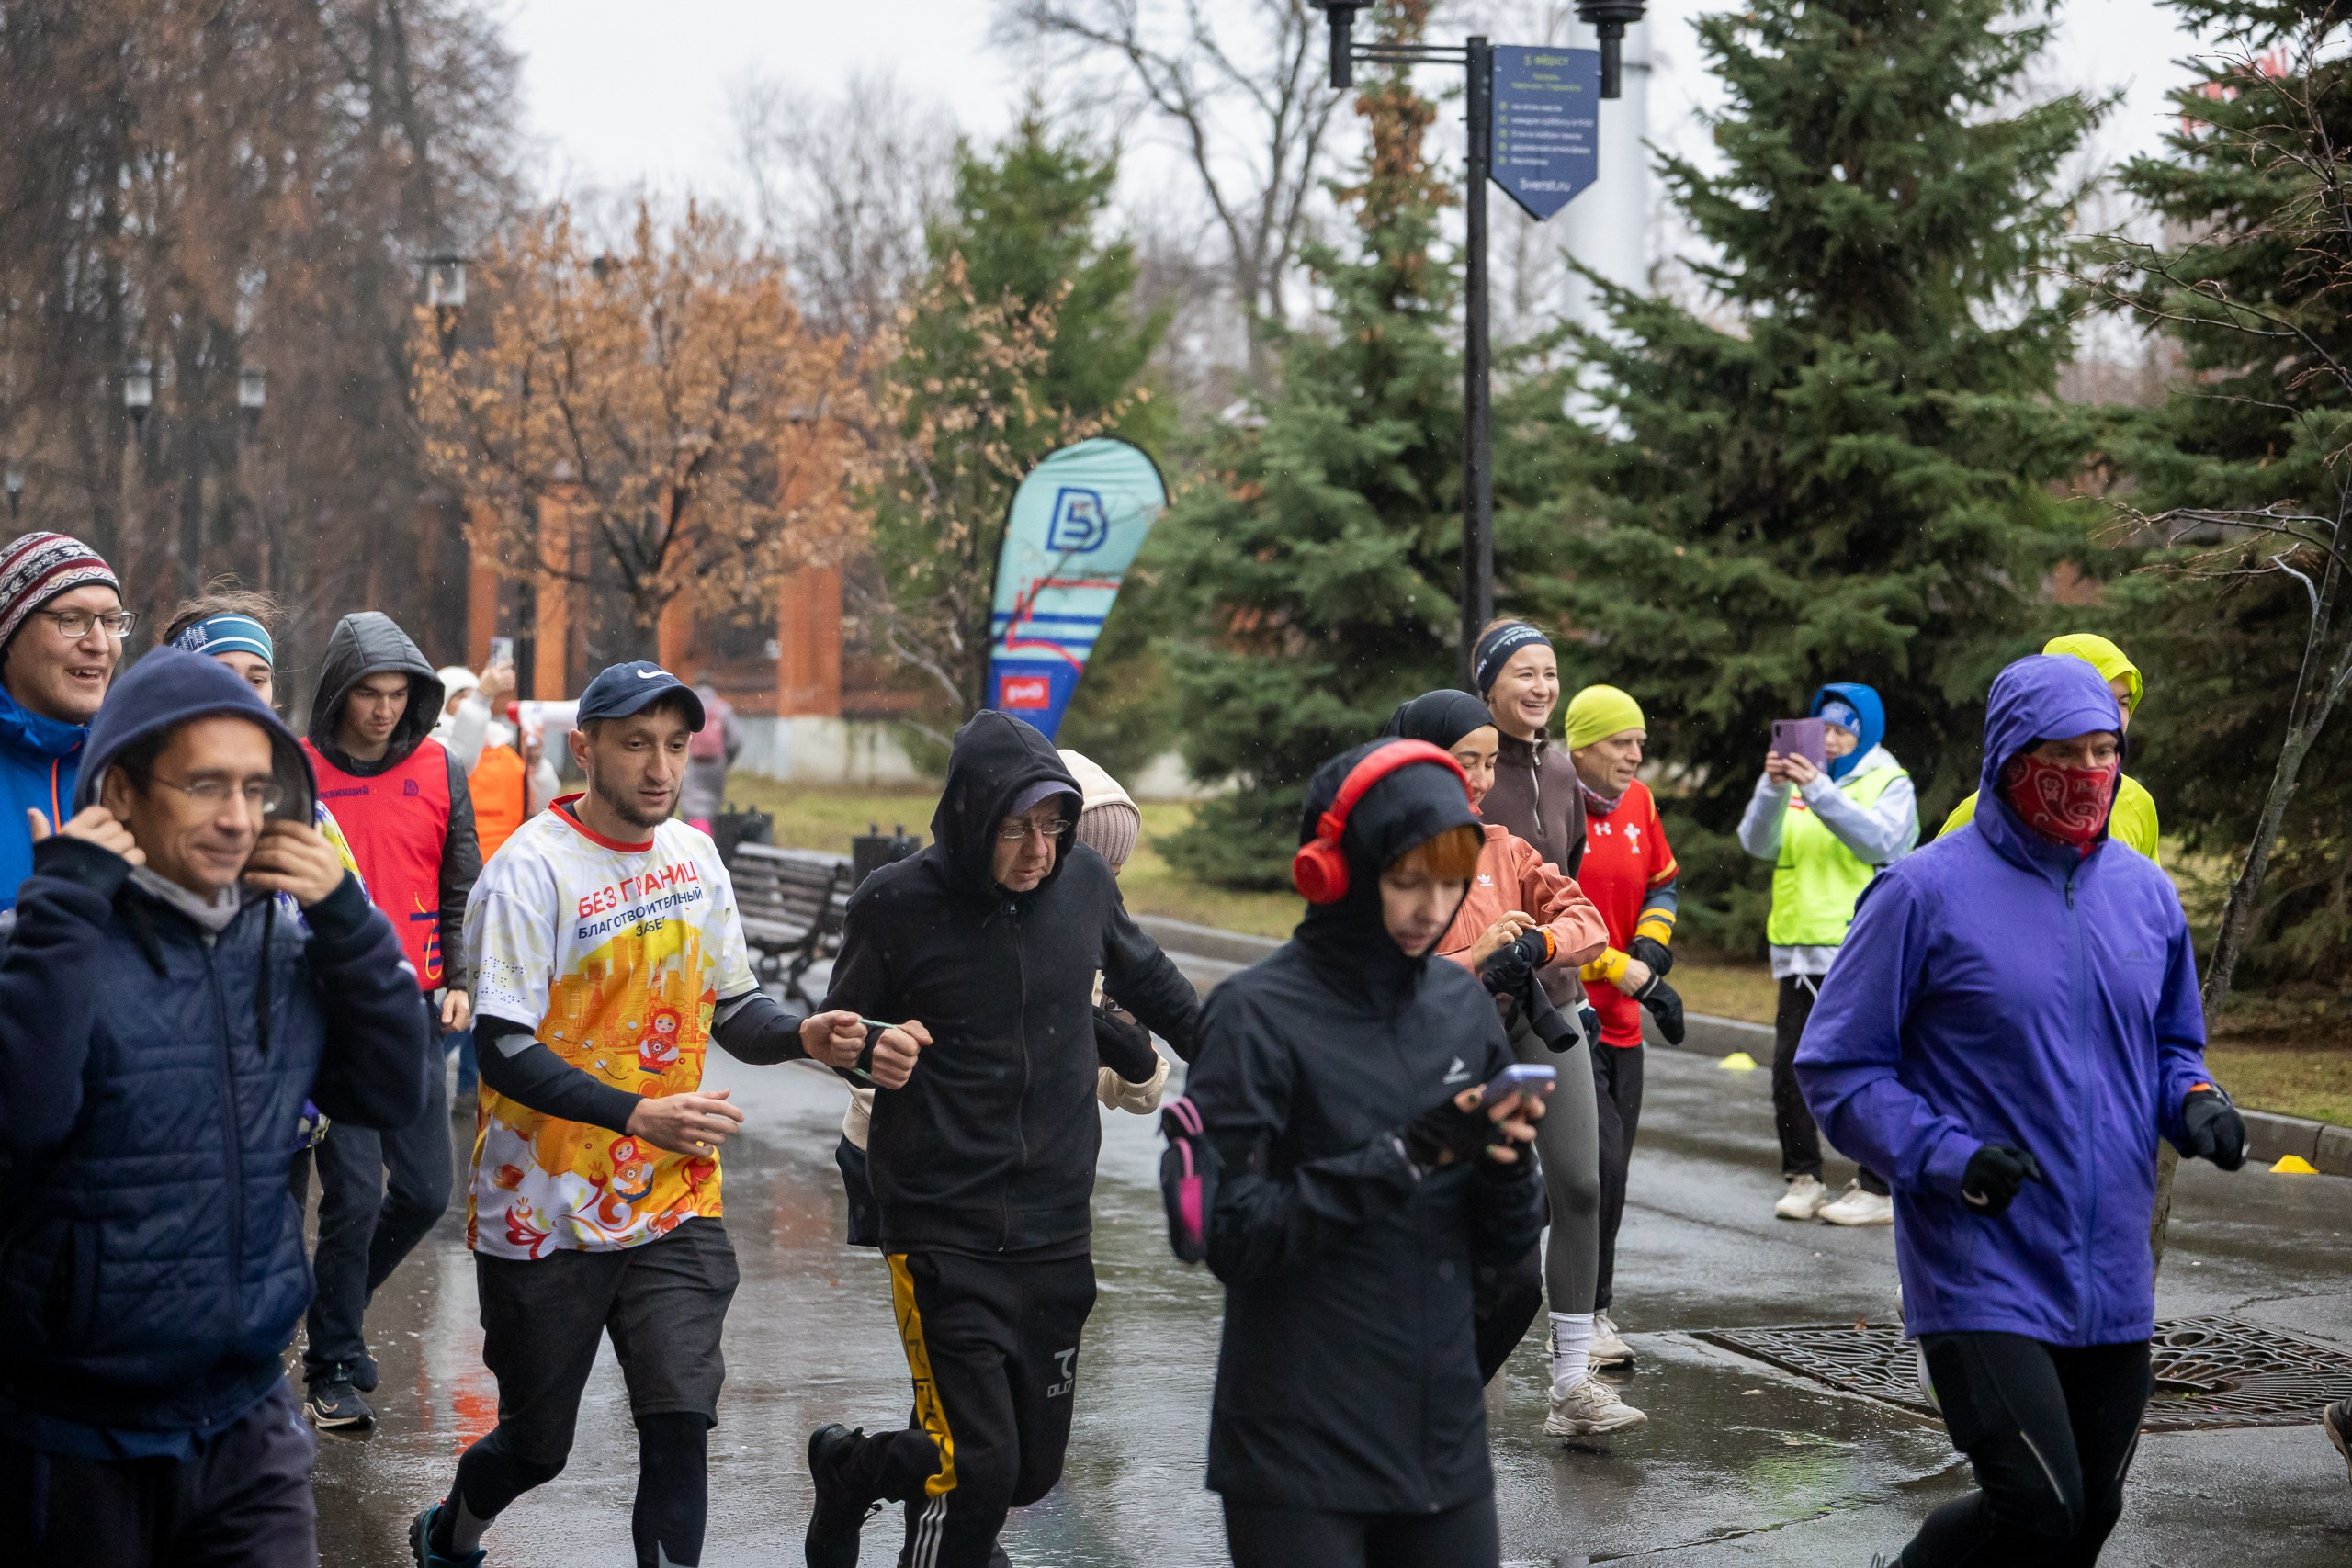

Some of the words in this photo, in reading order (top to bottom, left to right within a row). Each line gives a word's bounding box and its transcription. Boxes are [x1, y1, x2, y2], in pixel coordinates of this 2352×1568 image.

[578, 886, 617, 919] БЕЗ
[619, 861, 700, 903] ГРАНИЦ
[578, 886, 704, 940] БЛАГОТВОИТЕЛЬНЫЙ
